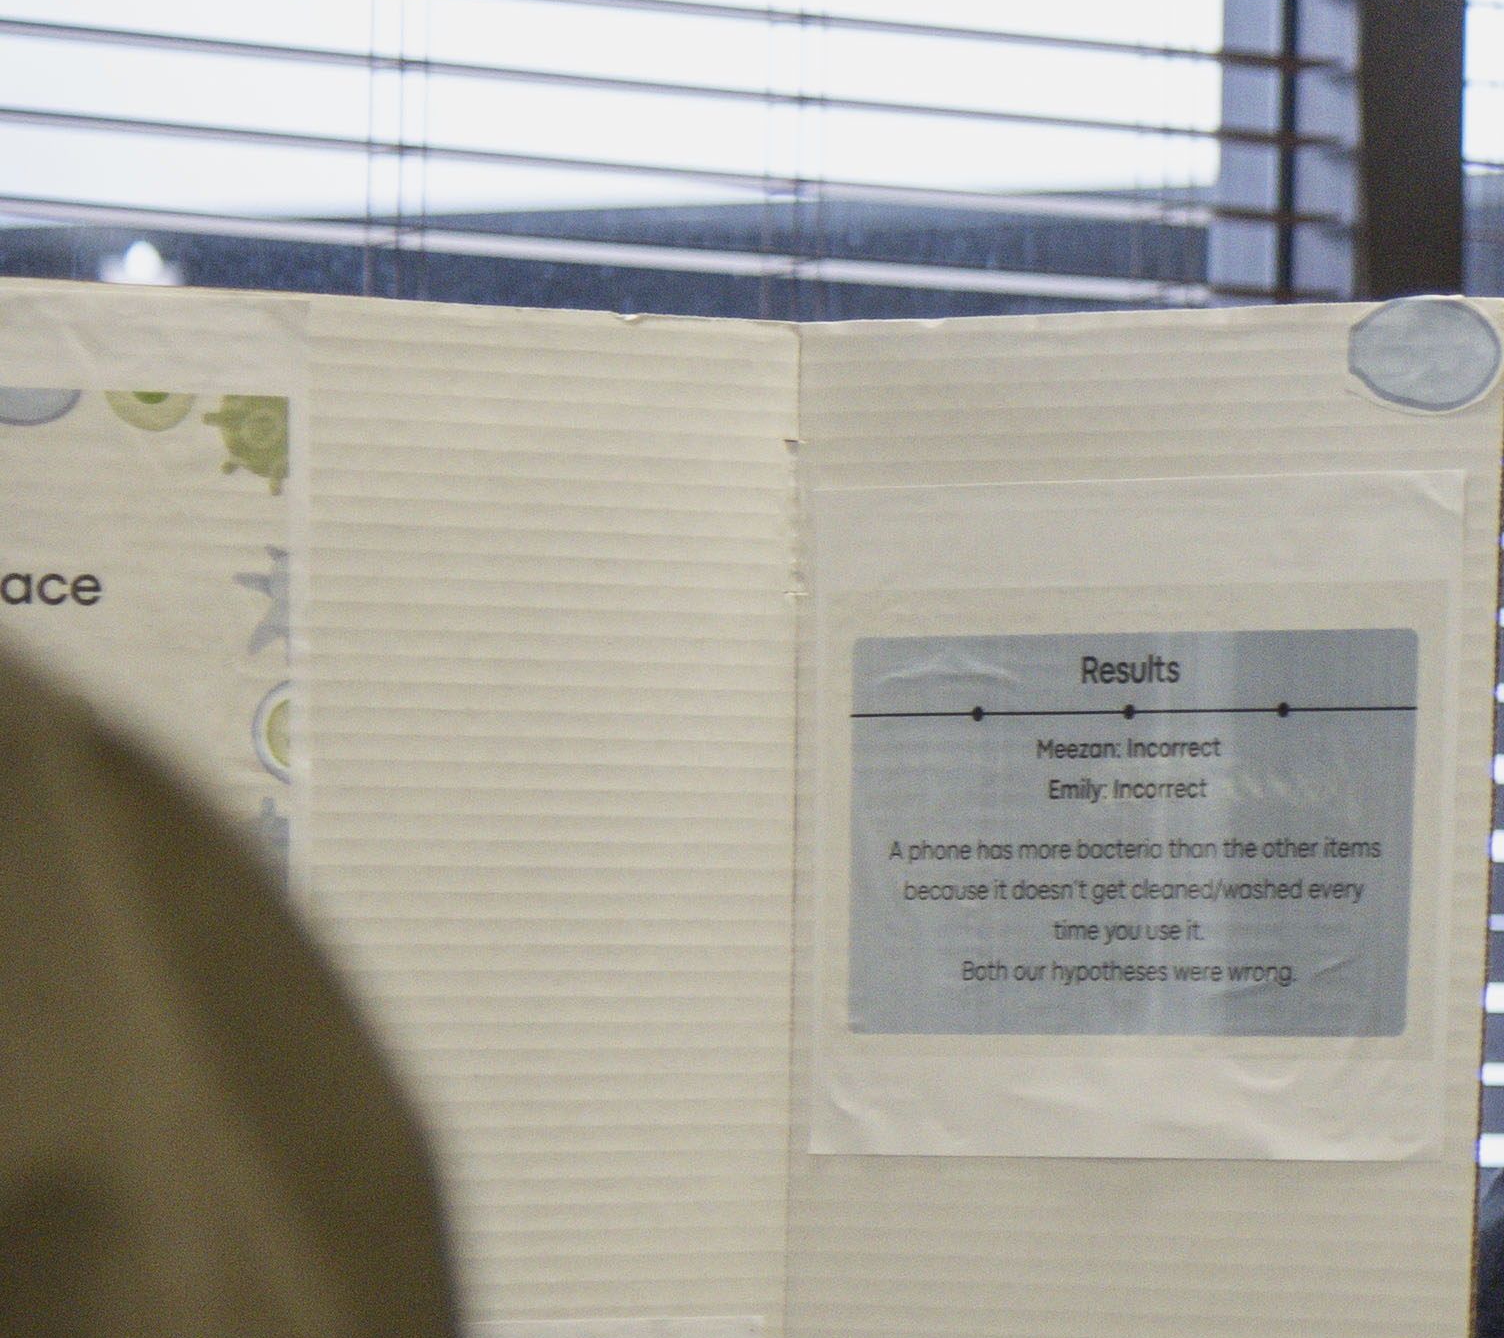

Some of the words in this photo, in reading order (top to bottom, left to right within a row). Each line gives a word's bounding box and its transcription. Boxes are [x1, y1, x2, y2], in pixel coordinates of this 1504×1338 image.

[1081, 654, 1180, 685] Results
[1036, 738, 1121, 759] Meezan:
[1127, 737, 1221, 758] Incorrect
[1048, 778, 1107, 803] Emily:
[1113, 778, 1207, 799] Incorrect
[889, 840, 903, 860] A
[908, 839, 972, 863] phone
[977, 839, 1013, 860] has
[1018, 842, 1072, 859] more
[1076, 837, 1162, 859] bacteria
[1168, 838, 1217, 859] than
[1223, 837, 1257, 858] the
[1262, 837, 1318, 858] other
[1323, 836, 1382, 858] items
[904, 880, 990, 900] because
[993, 879, 1007, 900] it
[1012, 879, 1087, 900] doesn't
[1091, 880, 1126, 904] get
[1131, 878, 1302, 901] cleaned/washed
[1308, 881, 1364, 904] every
[1053, 919, 1099, 940] time
[1104, 922, 1140, 945] you
[1146, 923, 1182, 940] use
[962, 960, 1007, 981] Both
[1013, 964, 1046, 981] our
[1051, 961, 1167, 986] hypotheses
[1173, 964, 1222, 981] were
